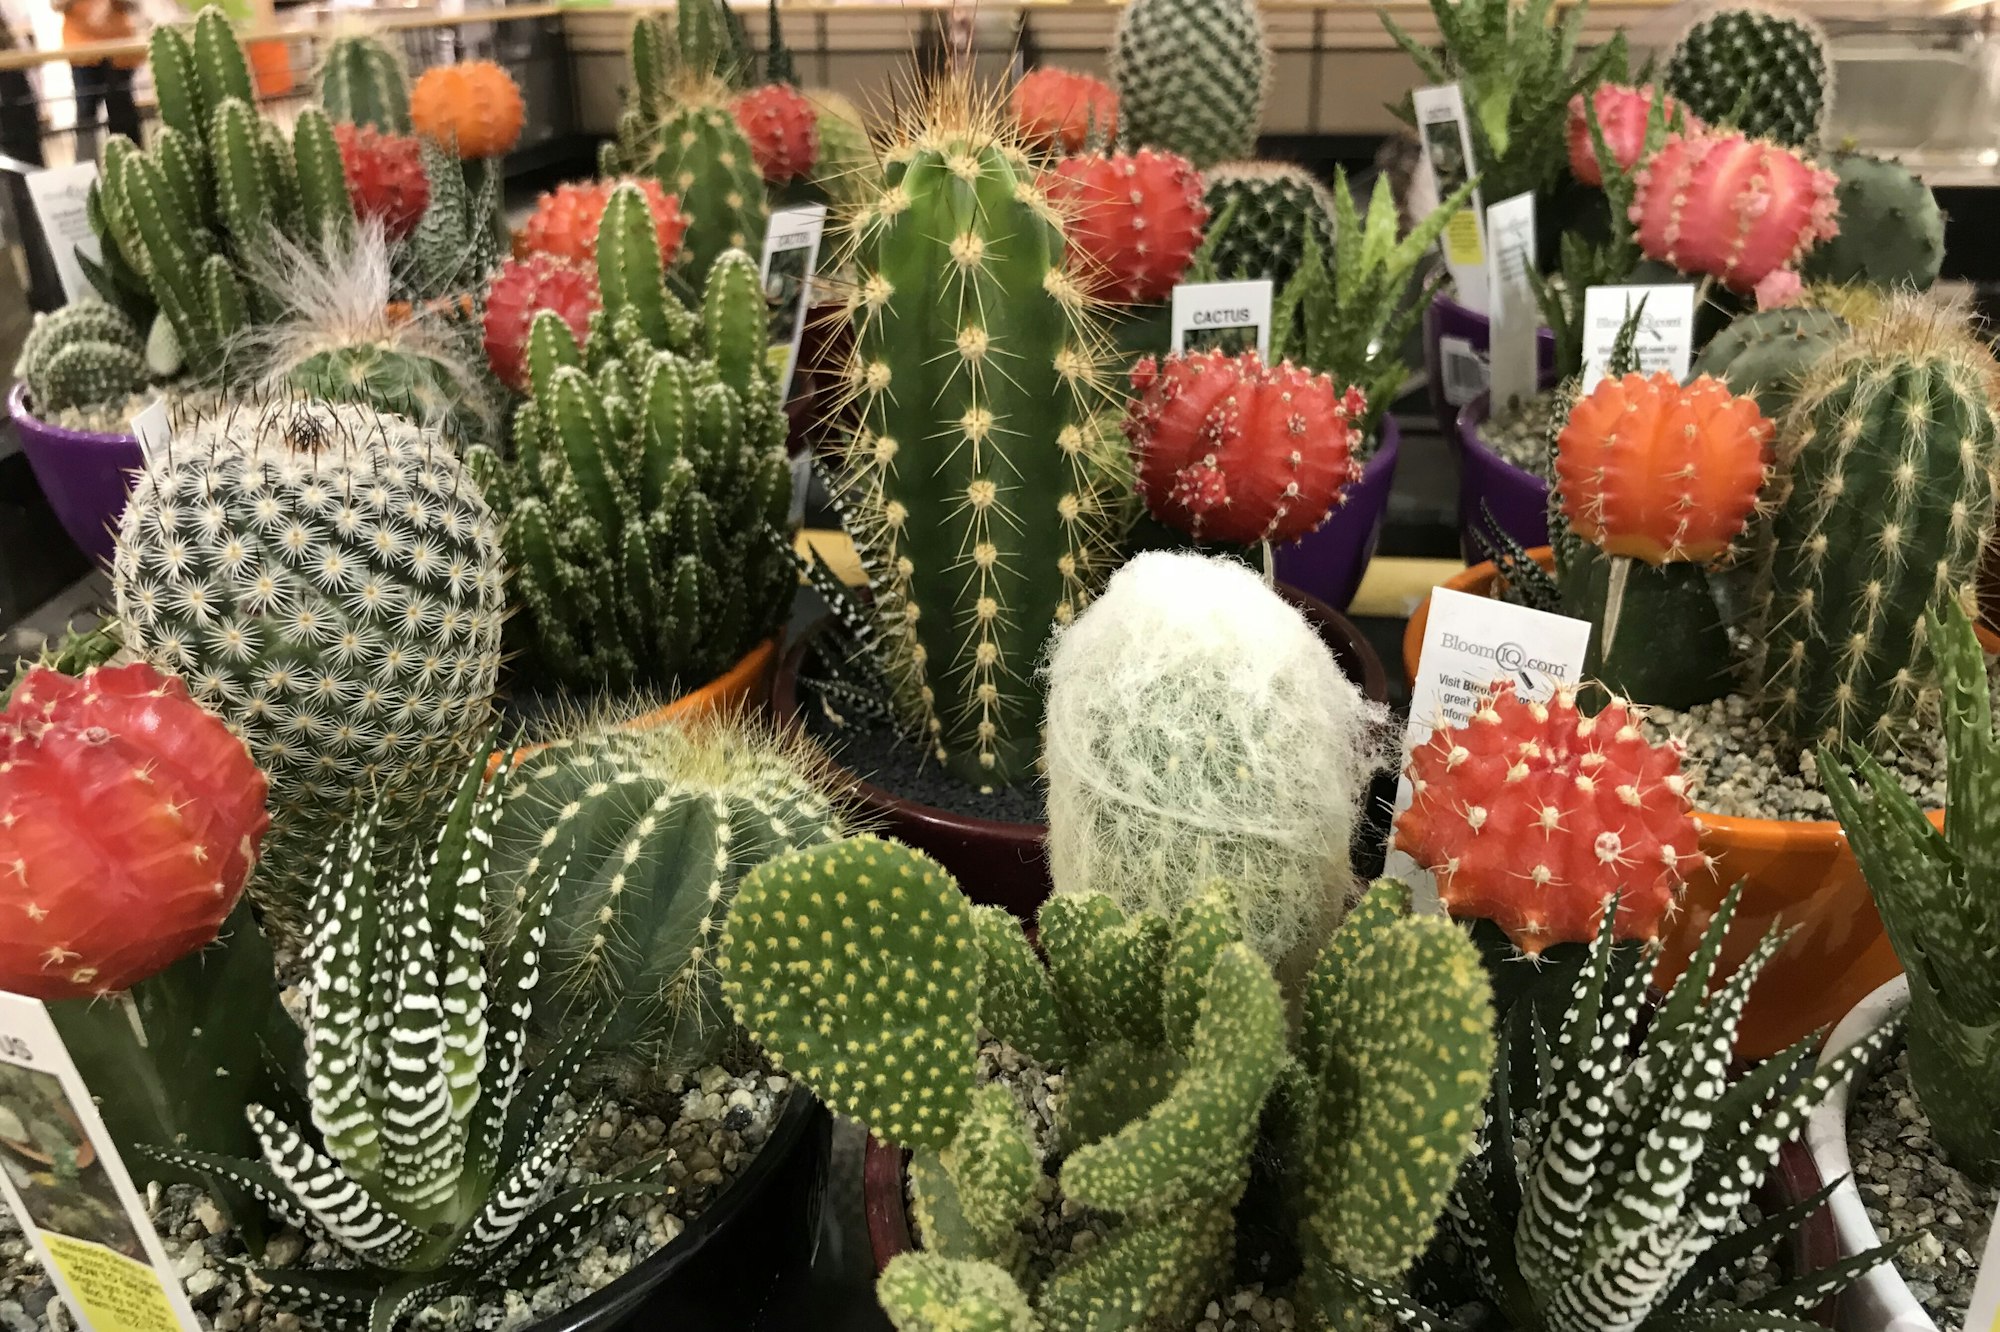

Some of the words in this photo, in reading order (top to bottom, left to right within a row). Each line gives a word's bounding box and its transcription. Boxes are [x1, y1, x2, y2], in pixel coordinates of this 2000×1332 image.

[1193, 308, 1250, 325] CACTUS
[1439, 673, 1461, 689] Visit
[1443, 693, 1471, 706] great
